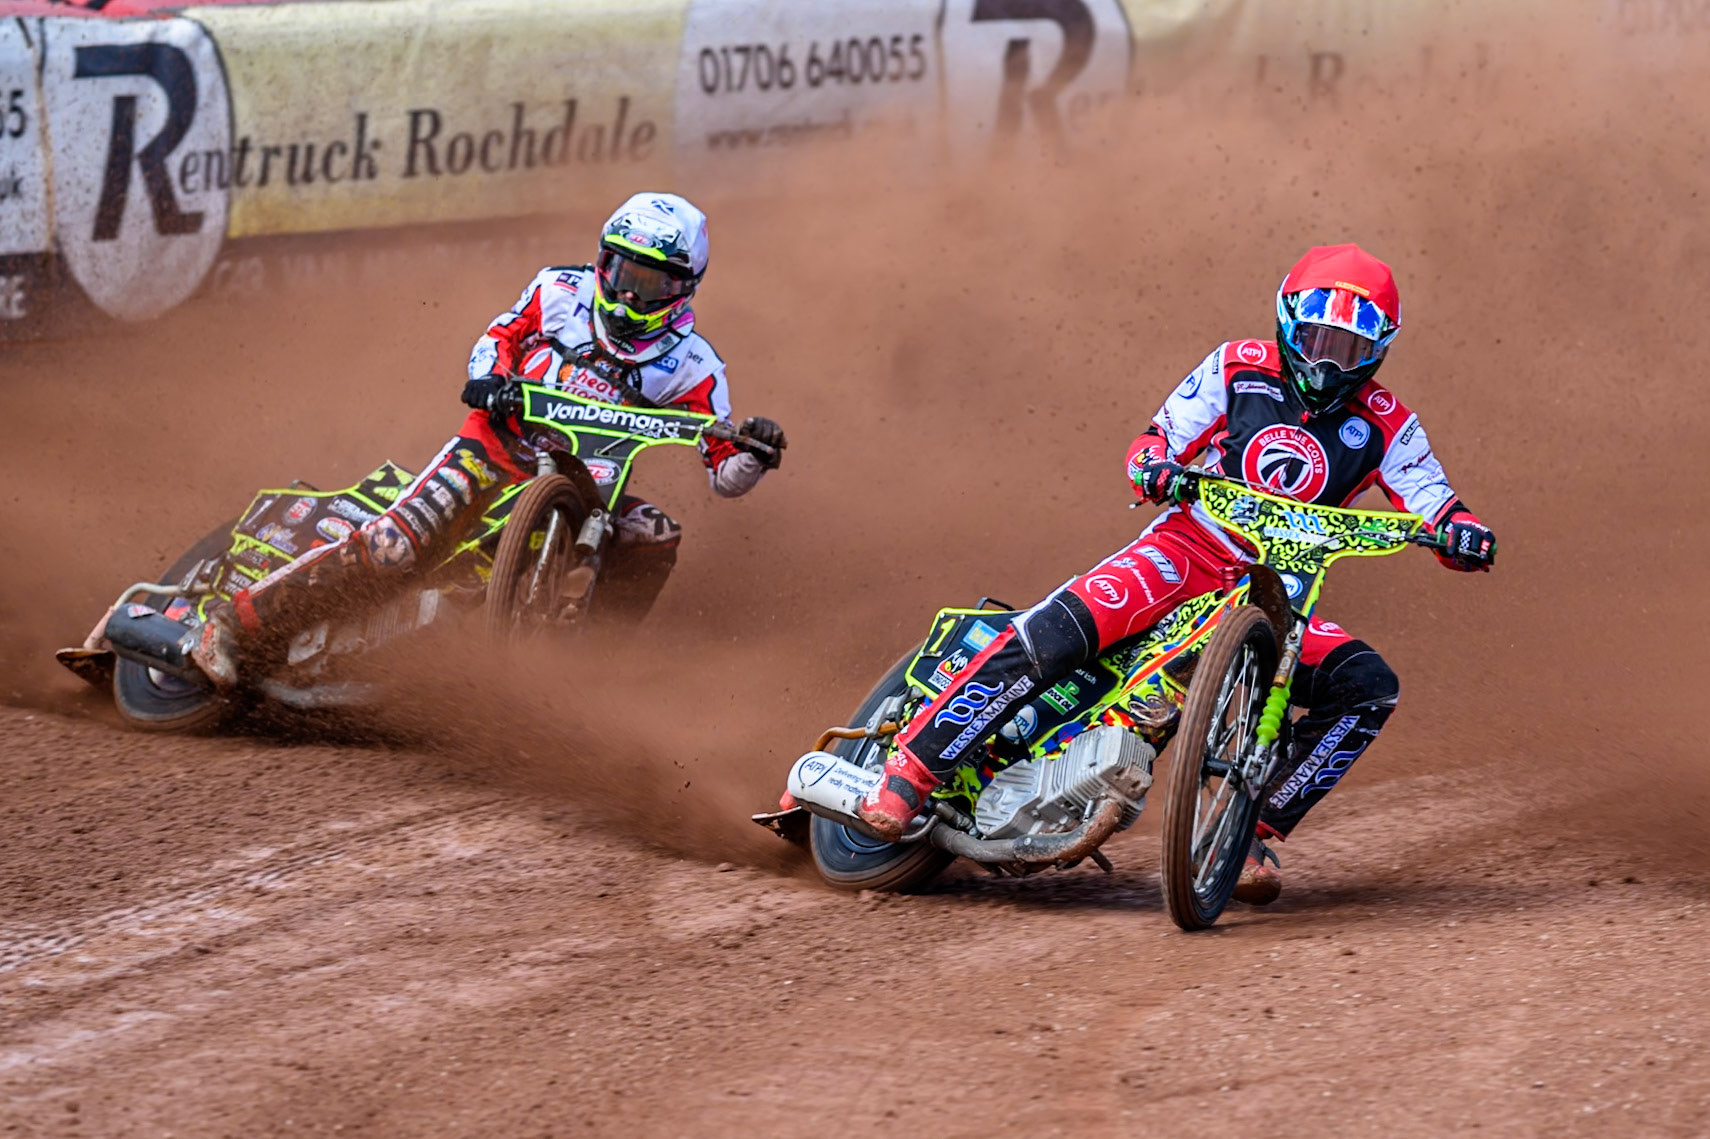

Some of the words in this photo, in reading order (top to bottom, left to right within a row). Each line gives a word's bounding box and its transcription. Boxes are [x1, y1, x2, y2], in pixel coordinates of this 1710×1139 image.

[700, 43, 795, 95] 01706
[806, 35, 926, 88] 640055
[403, 97, 657, 179] Rochdale
[1242, 347, 1262, 357] ATPI
[1373, 395, 1391, 410] ATPI
[1345, 425, 1365, 440] ATPI
[1258, 430, 1287, 446] BELLE
[1289, 431, 1308, 445] VUE
[1306, 443, 1324, 474] COLTS
[1093, 579, 1120, 602] ATPI
[929, 618, 956, 652] 1
[804, 760, 827, 774] ATPI
